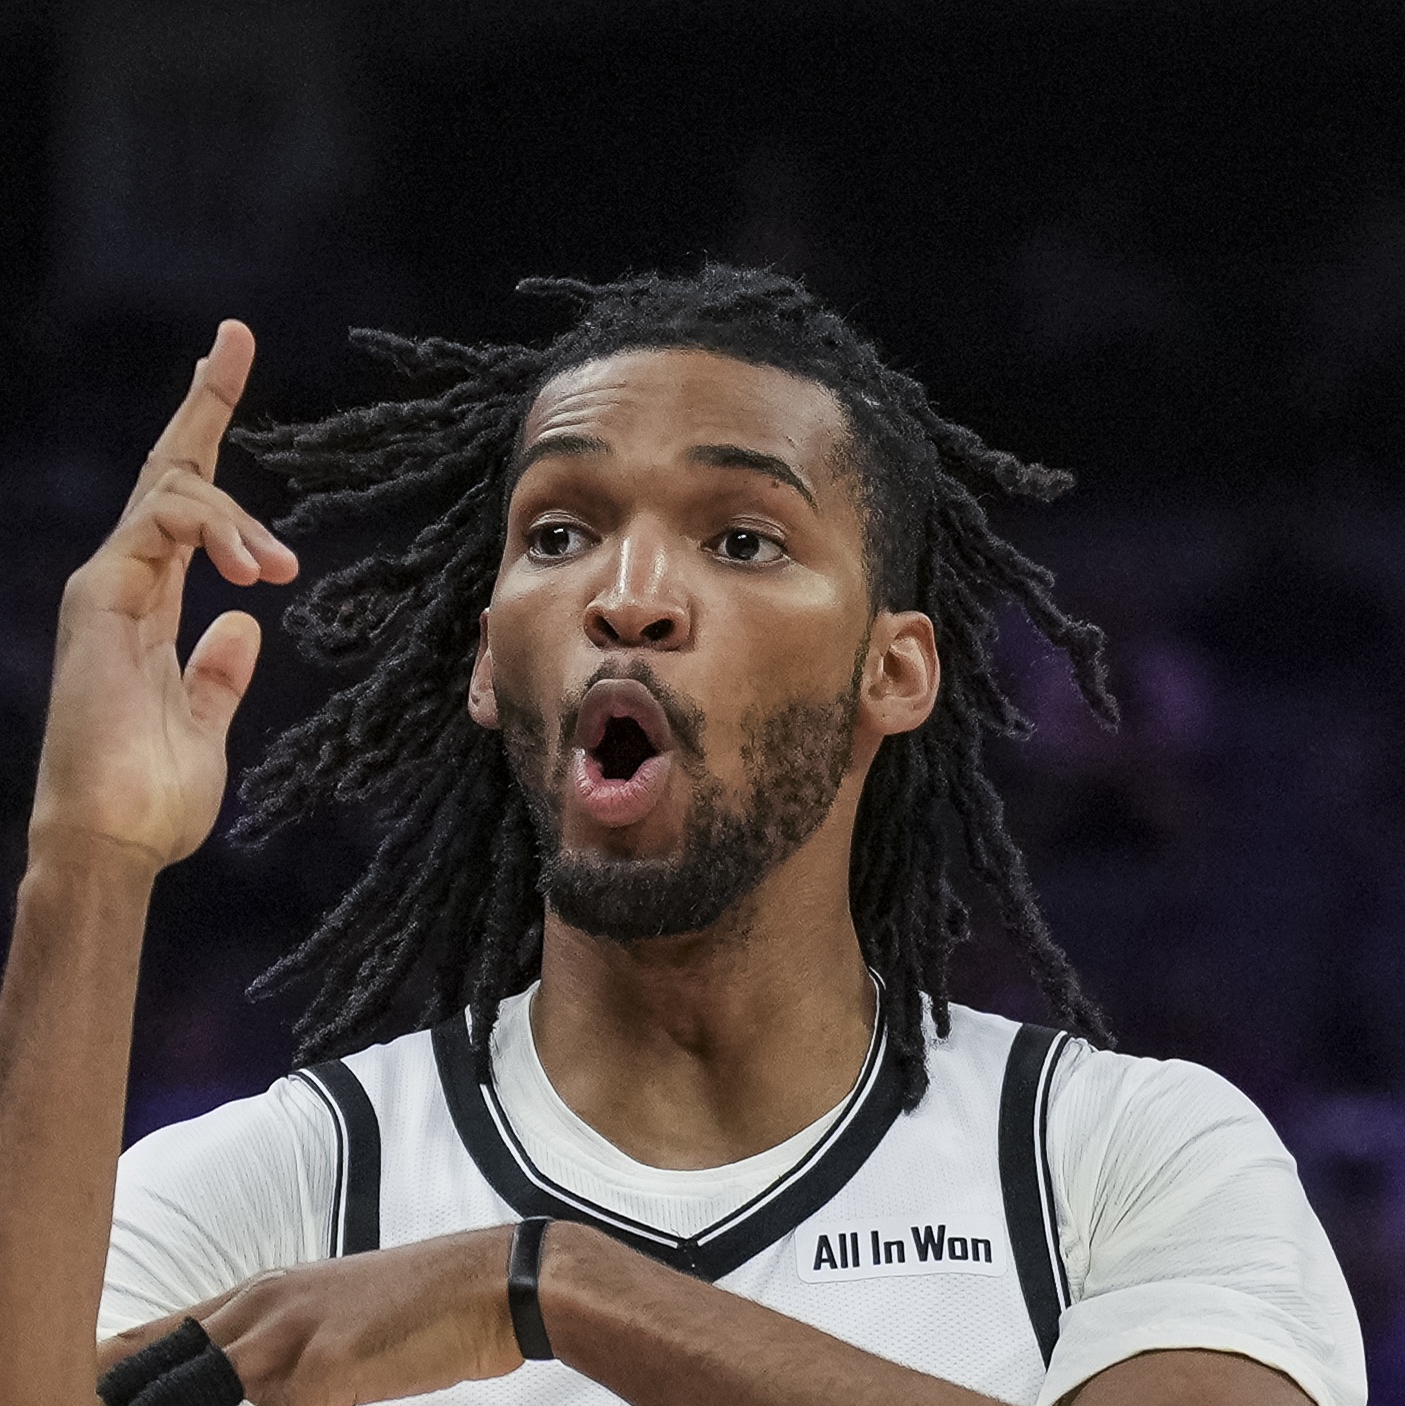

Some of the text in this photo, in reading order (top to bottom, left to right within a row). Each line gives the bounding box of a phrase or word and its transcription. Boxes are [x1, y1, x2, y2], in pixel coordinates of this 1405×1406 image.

[813, 1224, 992, 1270] All In Won
